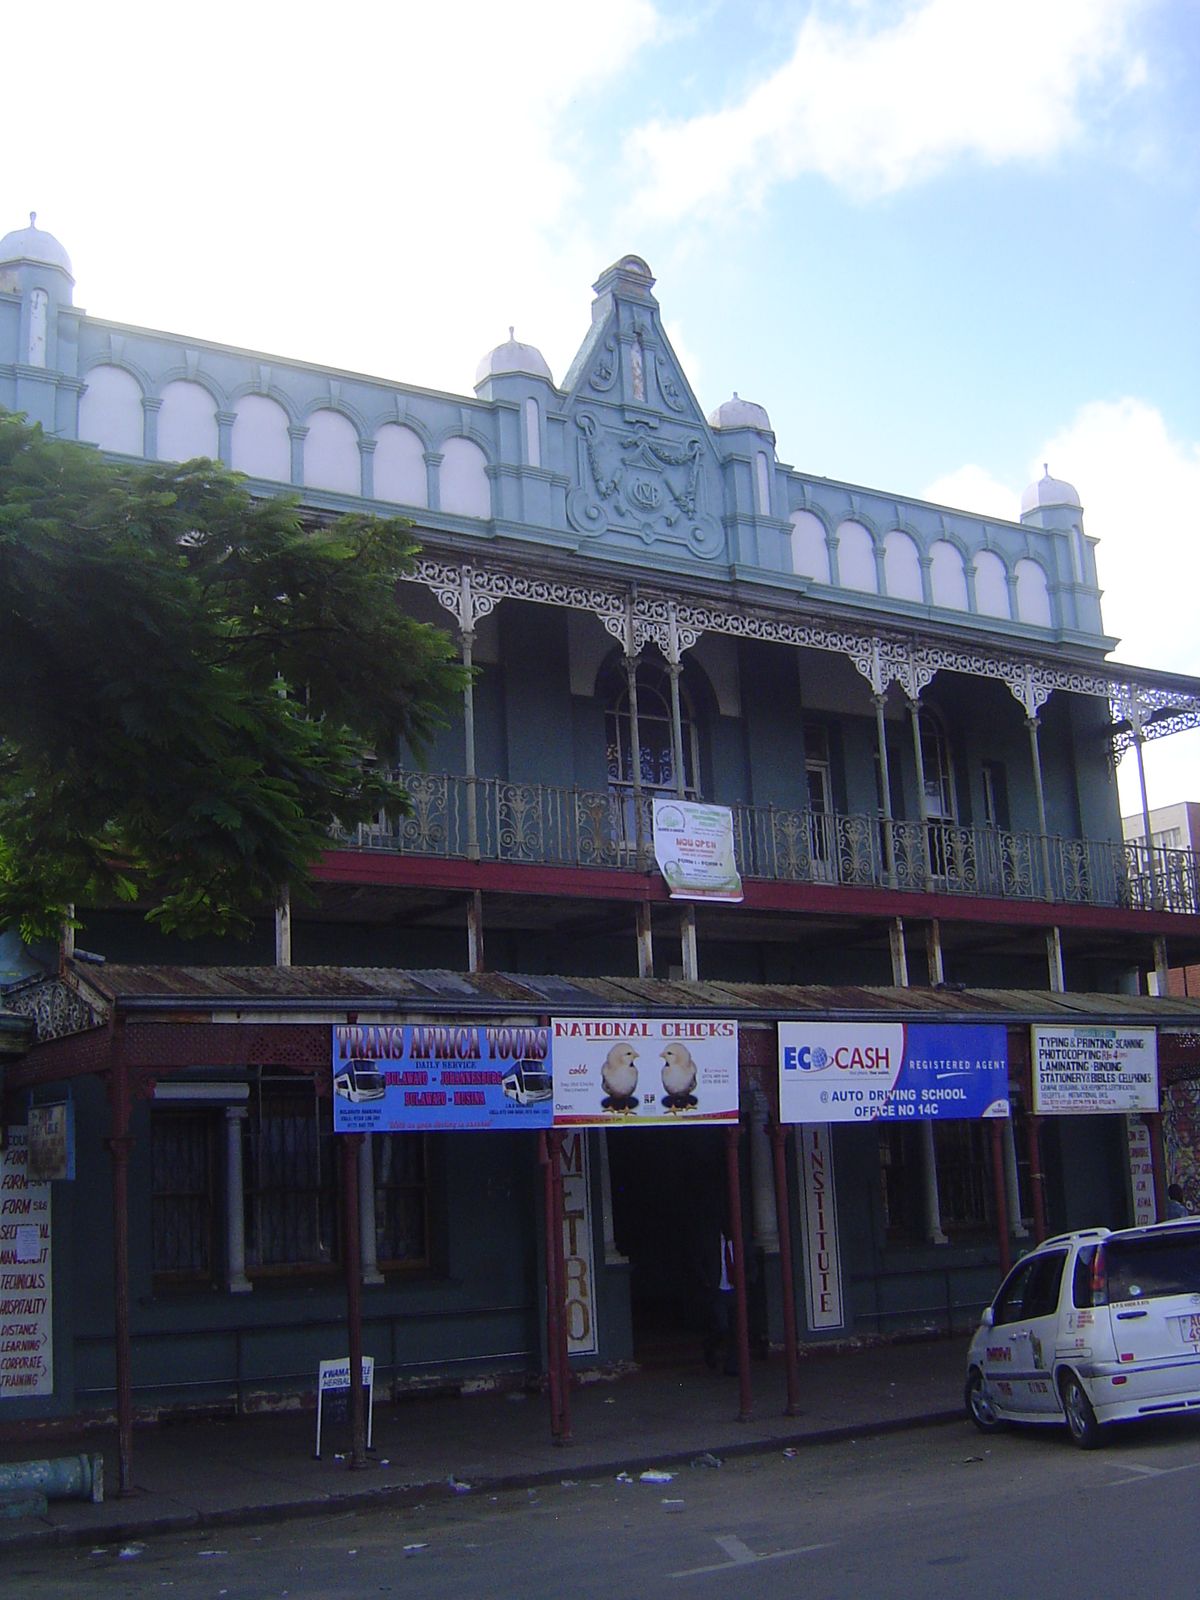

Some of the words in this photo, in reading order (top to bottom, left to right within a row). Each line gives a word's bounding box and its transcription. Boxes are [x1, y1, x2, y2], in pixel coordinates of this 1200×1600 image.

[695, 839, 716, 849] OPEN
[554, 1022, 653, 1037] NATIONAL
[661, 1023, 734, 1038] CHICKS
[336, 1026, 404, 1060] TRANS
[409, 1027, 482, 1060] AFRICA
[486, 1028, 548, 1060] TOURS
[1038, 1037, 1069, 1048] TYPING
[1039, 1049, 1101, 1060] PHOTOCOPYING
[415, 1061, 438, 1070] DAILY
[442, 1061, 477, 1070] SERVICE
[568, 1064, 588, 1076] cobb
[909, 1060, 971, 1071] REGISTERED
[975, 1060, 1006, 1070] AGENT
[1040, 1061, 1089, 1072] LAMINATING
[384, 1071, 428, 1086] BULAWAYO
[440, 1071, 502, 1086] JOHANNESBURG
[1040, 1073, 1086, 1083] STATIONERY
[1091, 1073, 1116, 1083] BIBLES
[1118, 1073, 1151, 1083] CELLPHONES
[404, 1091, 447, 1106] BULAWAYO
[454, 1091, 486, 1106] MUSINA
[832, 1090, 864, 1102] AUTO
[869, 1088, 916, 1101] DRIVING
[921, 1088, 967, 1101] SCHOOL
[854, 1105, 895, 1117] OFFICE
[898, 1104, 915, 1116] NO
[918, 1103, 939, 1116] 14C
[2, 1199, 31, 1214] FORM
[811, 1131, 832, 1313] INSTITUTE
[559, 1132, 590, 1342] METRO
[1, 1323, 38, 1336] DISTANCE
[1, 1340, 40, 1353] LEARNING
[1, 1356, 42, 1370] CORPORATE
[0, 1374, 38, 1387] TRAINING
